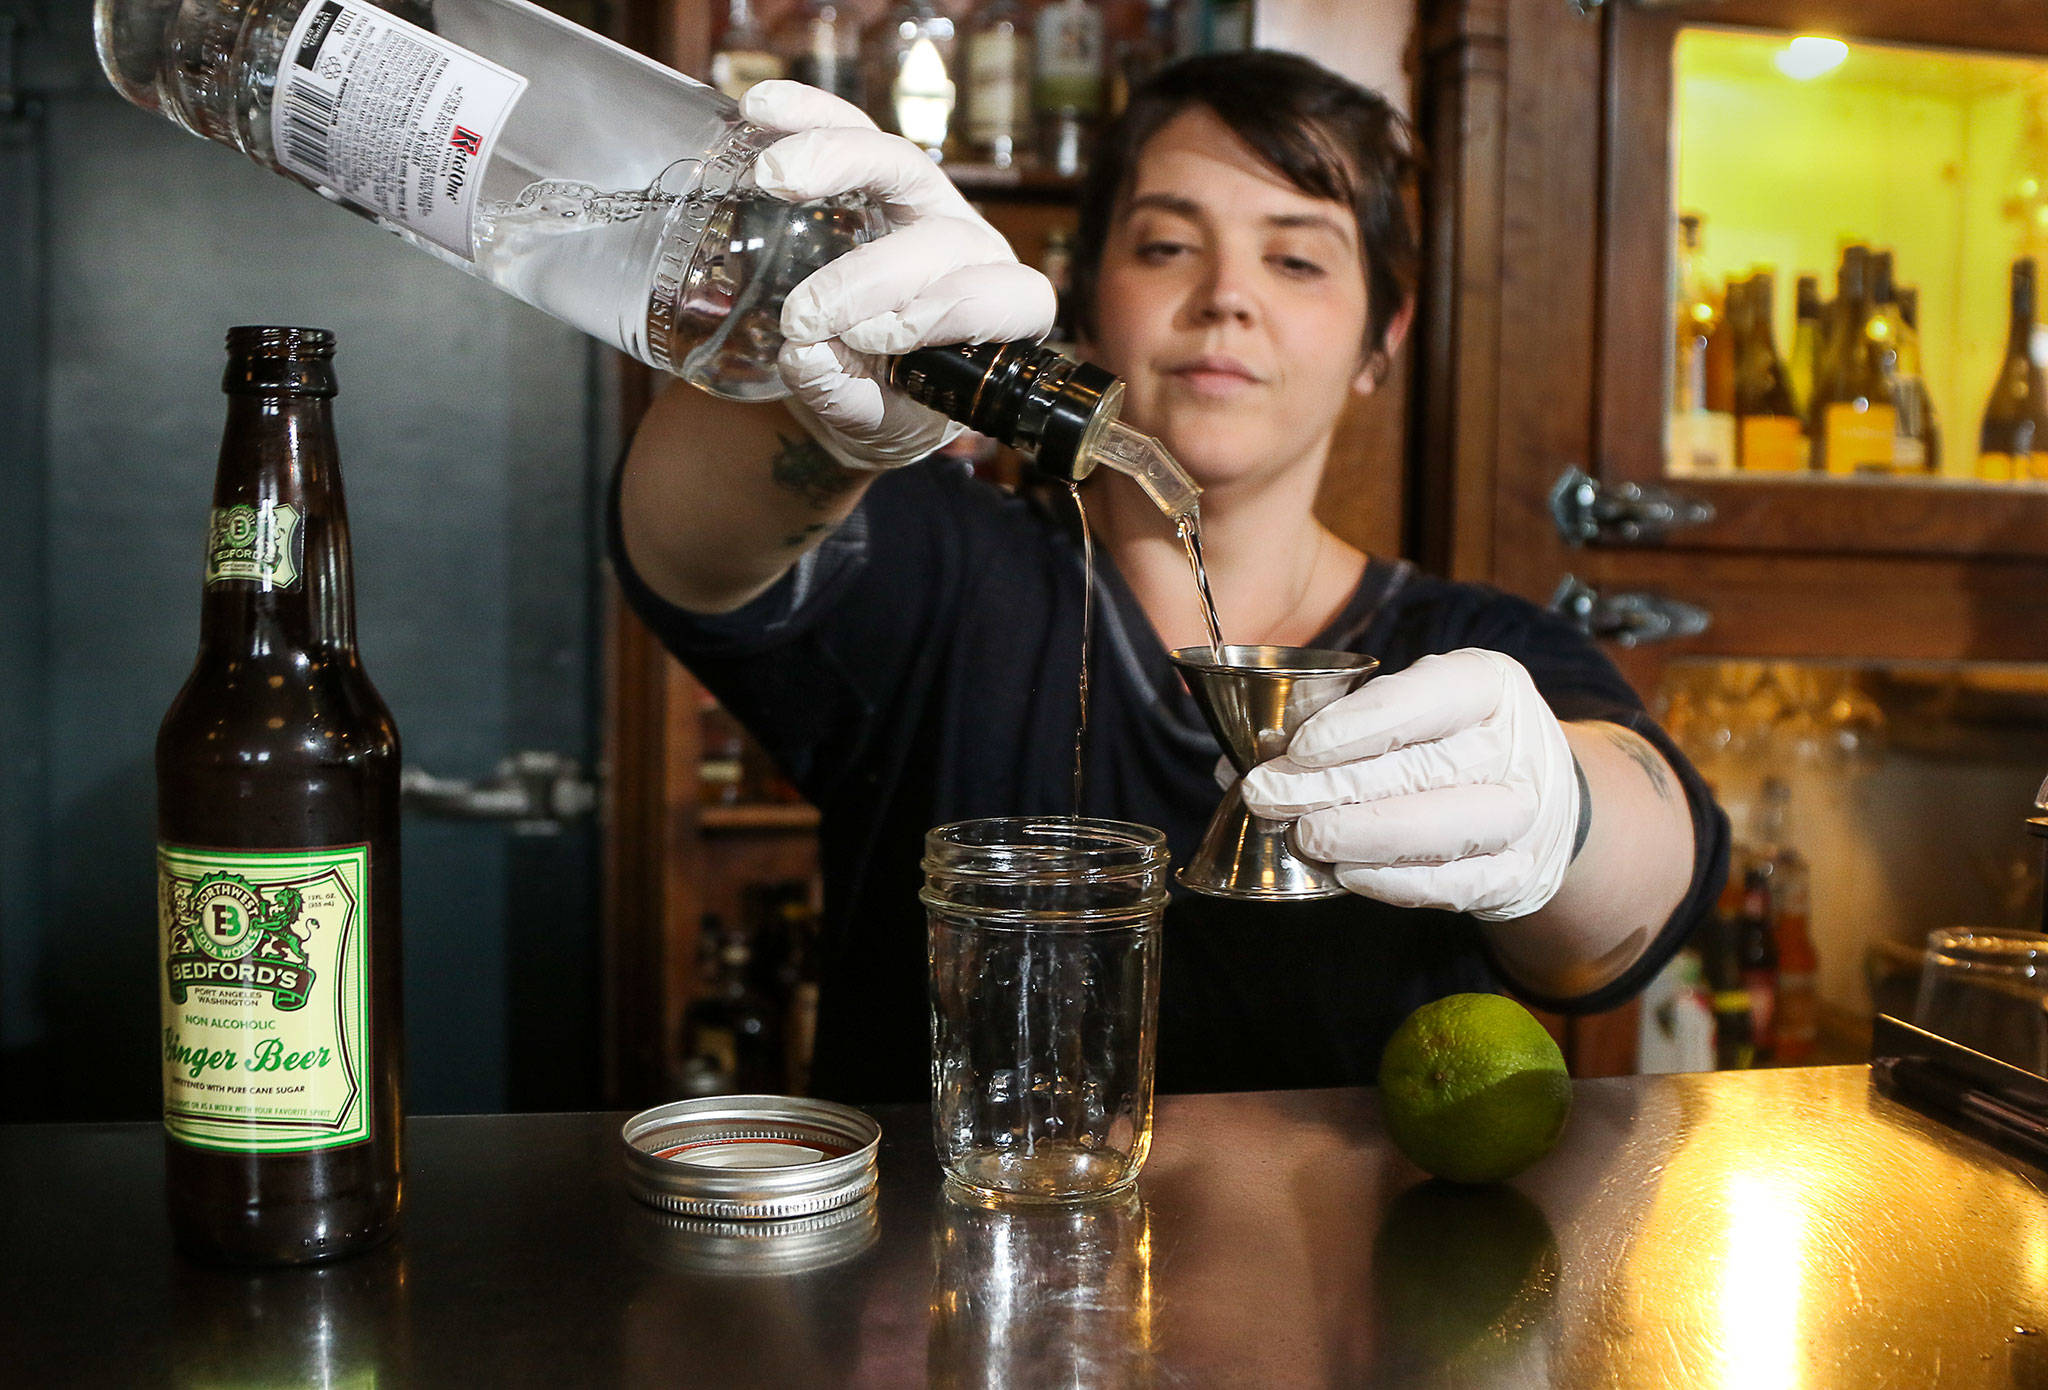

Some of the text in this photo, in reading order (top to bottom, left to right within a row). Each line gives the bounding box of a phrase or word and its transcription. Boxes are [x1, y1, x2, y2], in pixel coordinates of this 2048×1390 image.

[331, 13, 354, 36] LITER
[409, 51, 439, 96] GOVERNMENT
[415, 129, 429, 142] NO
[409, 140, 425, 167] SUGAR
[439, 147, 452, 178] VODKA
[190, 884, 259, 916] NORTHWEST
[195, 926, 259, 958] SODA WORKS
[171, 961, 299, 990] BEDFORD'S
[194, 988, 262, 999] PORT ANGELES
[198, 997, 258, 1007] WASHINGTON
[185, 1015, 276, 1030] NON ALCOHOLIC
[244, 1037, 331, 1072] Beer
[206, 1084, 225, 1093] WITH
[227, 1086, 247, 1094] PURE
[249, 1087, 273, 1095] CANE
[275, 1086, 306, 1095] SUGAR
[234, 1105, 252, 1113] WITH
[254, 1106, 273, 1115] YOUR
[274, 1107, 307, 1117] FAVORITE
[308, 1109, 332, 1117] SPIRIT
